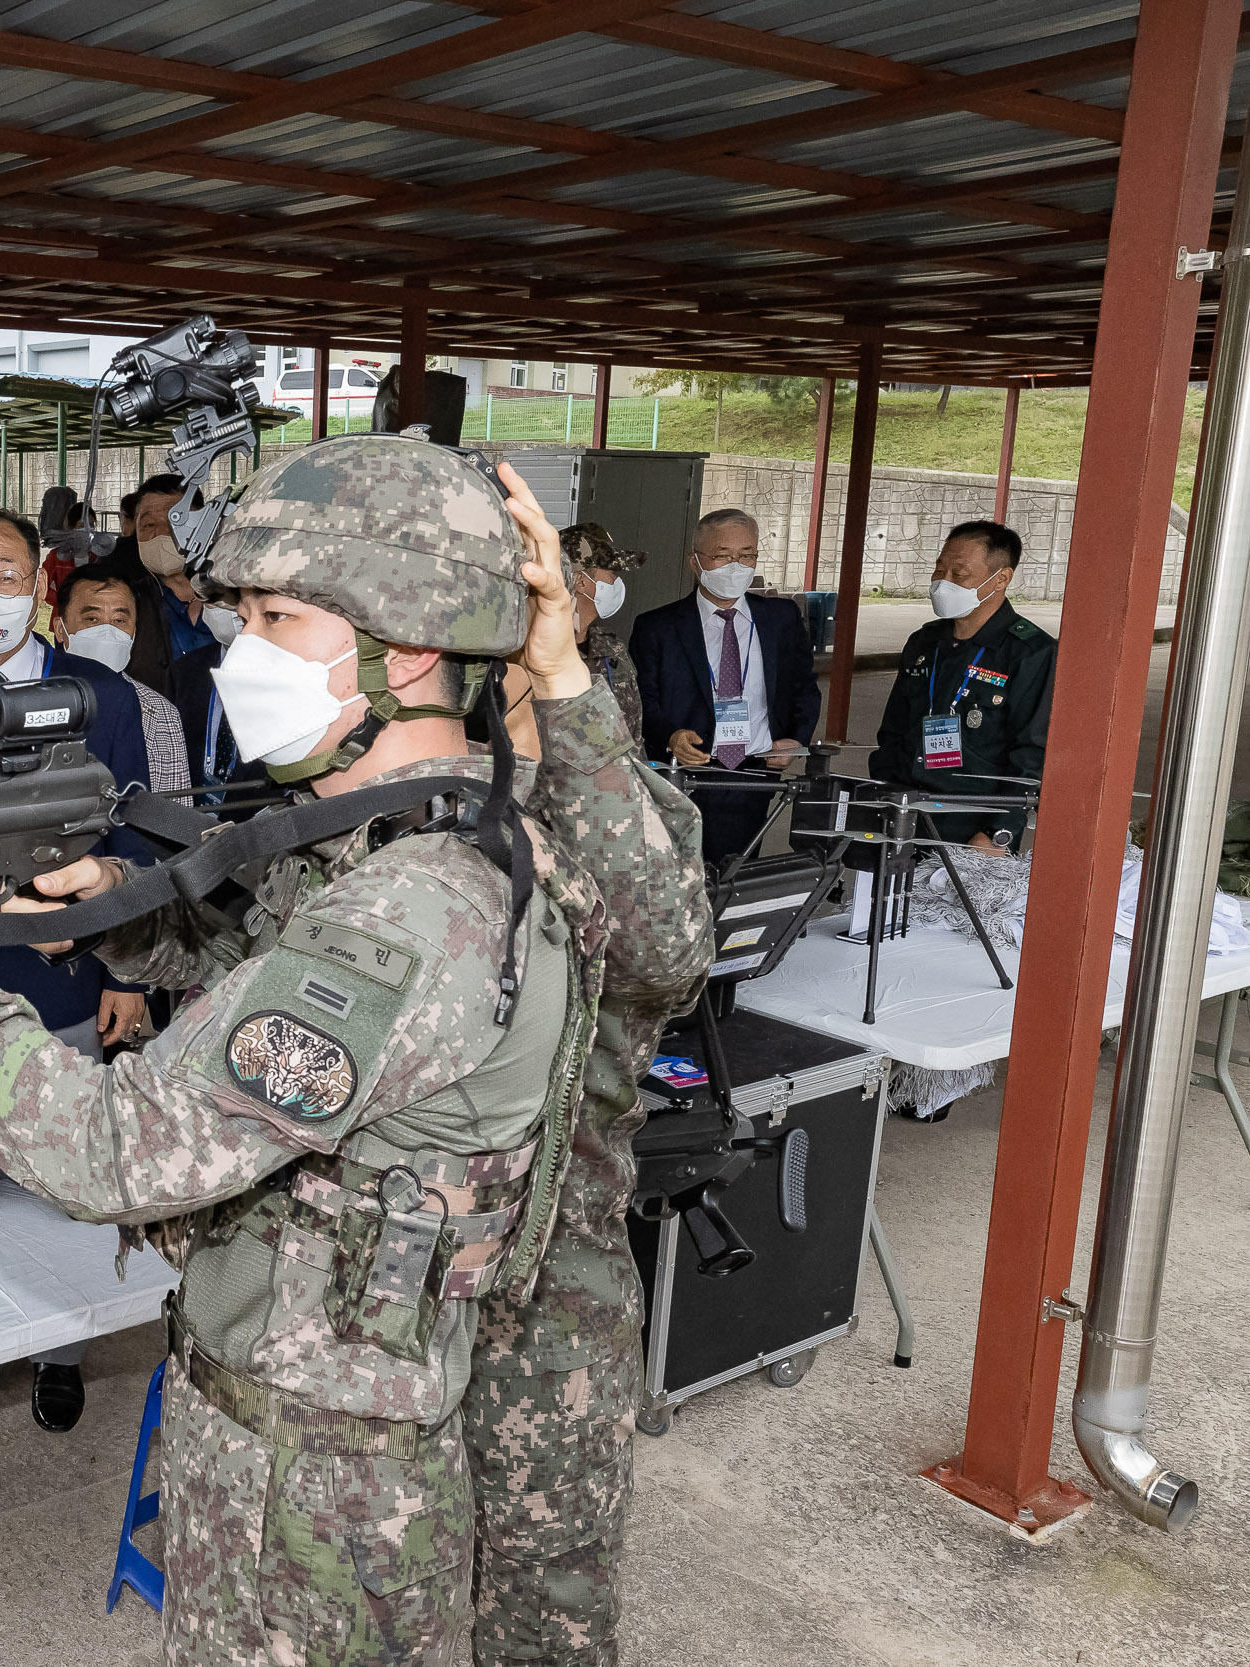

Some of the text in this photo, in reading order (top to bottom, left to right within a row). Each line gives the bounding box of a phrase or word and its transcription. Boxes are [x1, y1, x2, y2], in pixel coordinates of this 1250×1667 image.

[26, 710, 67, 725] 3소대장
[305, 925, 391, 966] 정 민
[324, 945, 357, 962] JEONG
